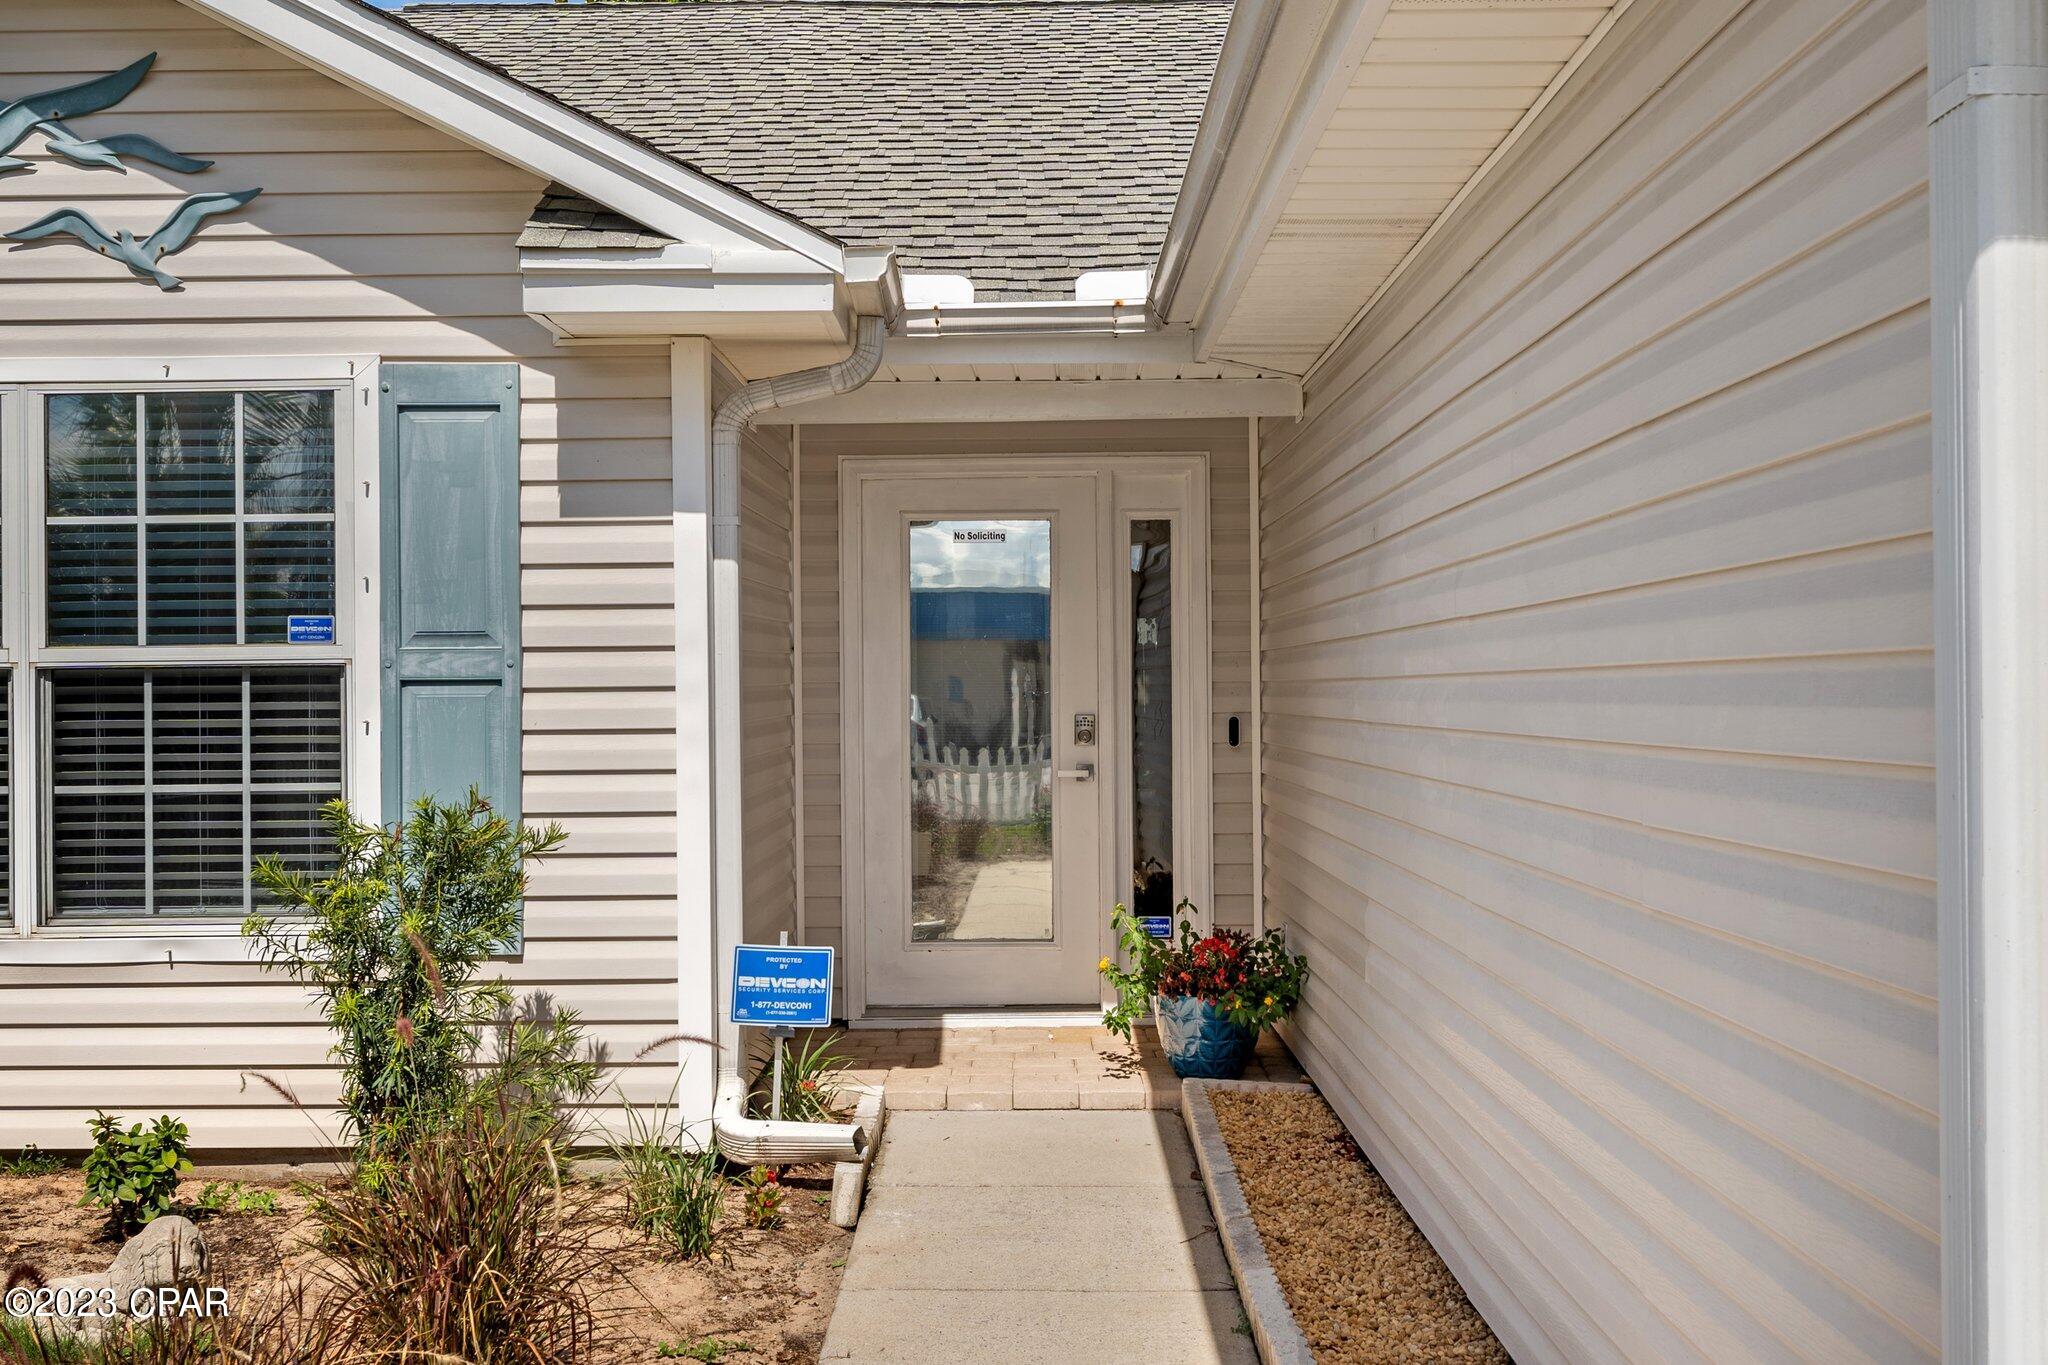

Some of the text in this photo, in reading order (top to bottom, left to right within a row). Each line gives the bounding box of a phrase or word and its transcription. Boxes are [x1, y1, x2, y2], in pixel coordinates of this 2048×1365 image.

[954, 531, 1006, 542] No Soliciting
[738, 976, 826, 989] DEVCON
[751, 1001, 812, 1010] 1-877-DEVCON1
